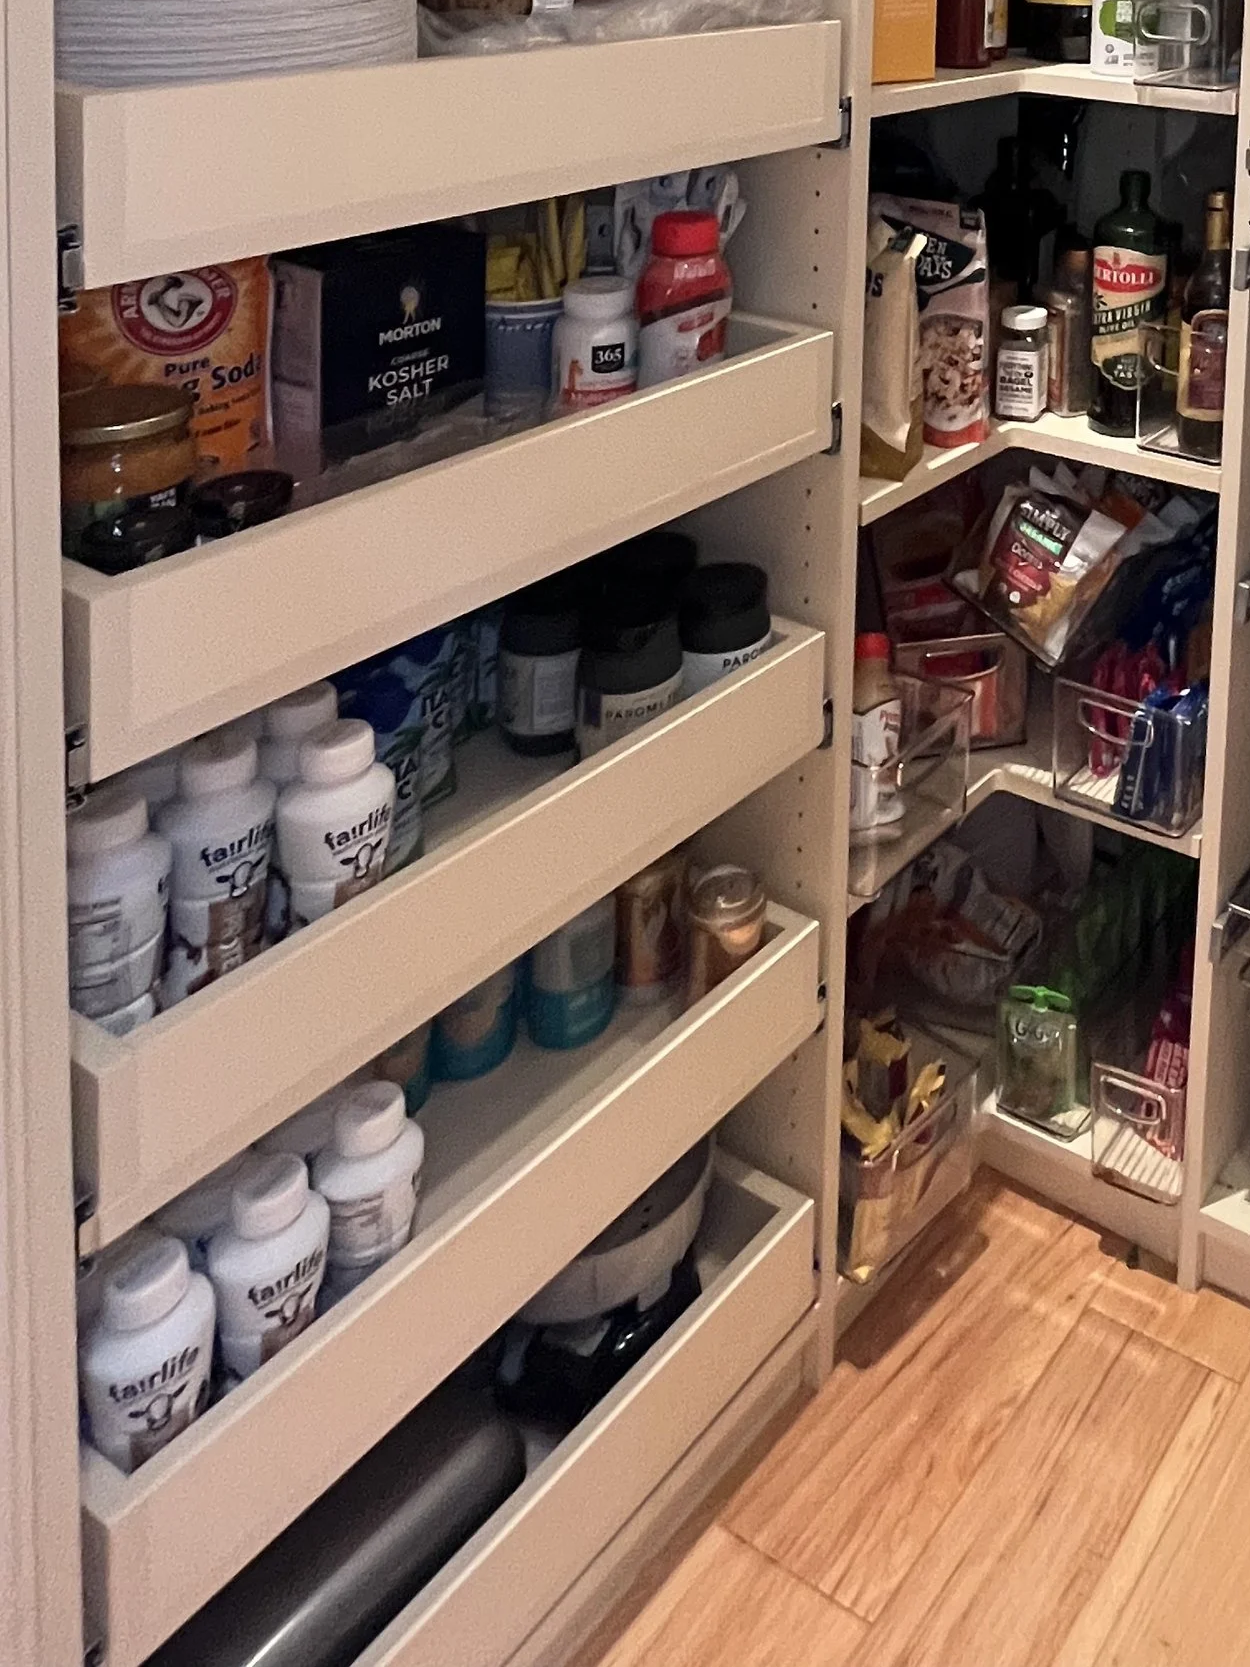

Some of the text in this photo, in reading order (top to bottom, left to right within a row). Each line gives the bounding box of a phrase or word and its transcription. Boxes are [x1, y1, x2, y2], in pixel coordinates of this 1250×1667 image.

[919, 253, 954, 280] DAYS
[1096, 267, 1155, 285] RTOLLI
[1093, 299, 1152, 326] TRA VIRGIN
[379, 317, 442, 346] MORTON
[163, 356, 211, 378] Pure
[594, 347, 622, 365] 365
[368, 354, 449, 393] KOSHER
[386, 378, 434, 406] SALT
[723, 648, 762, 669] PARO
[323, 802, 392, 852] fairlife
[247, 1247, 324, 1306] fairlife
[109, 1346, 201, 1403] fairlife
